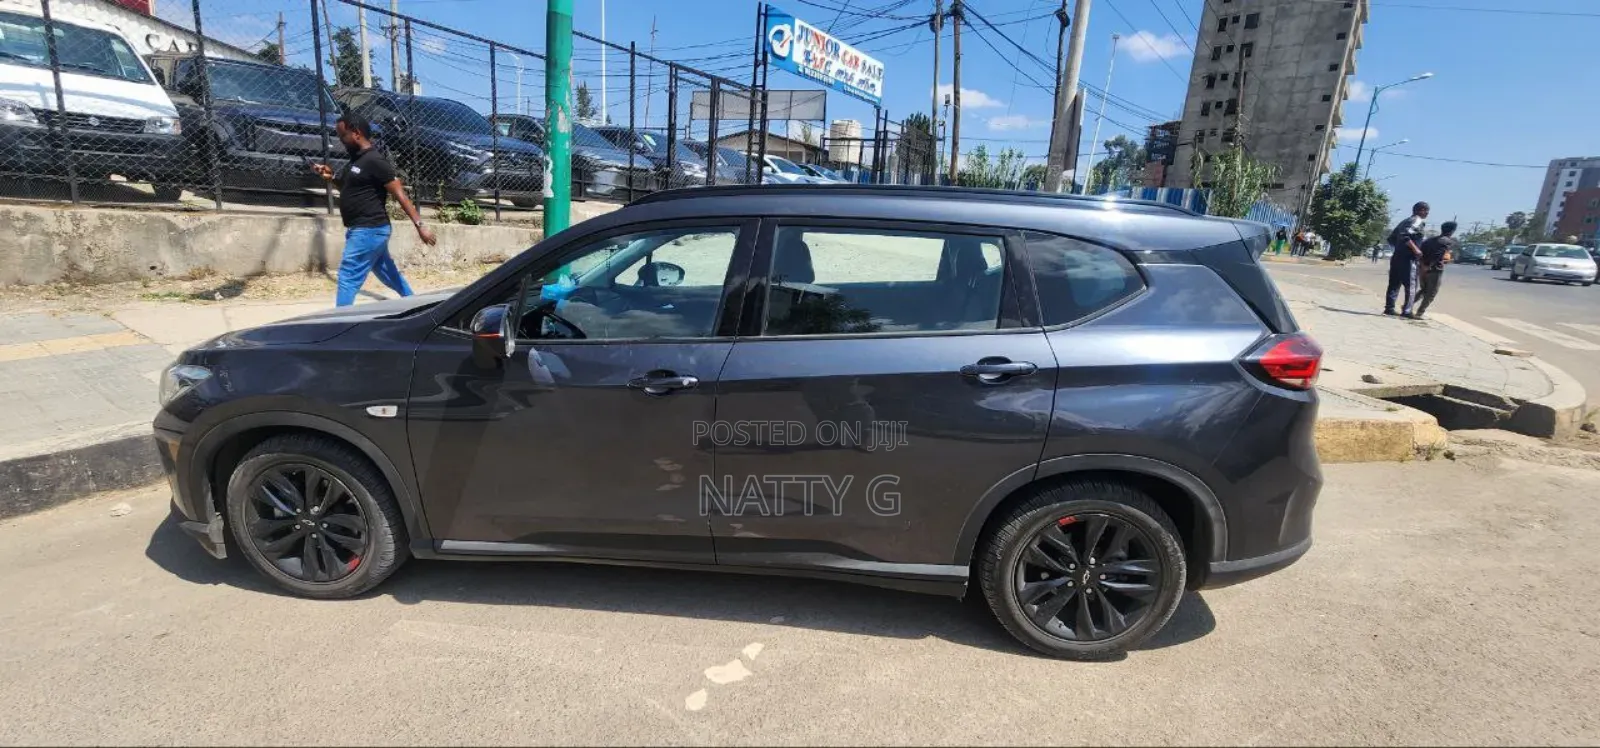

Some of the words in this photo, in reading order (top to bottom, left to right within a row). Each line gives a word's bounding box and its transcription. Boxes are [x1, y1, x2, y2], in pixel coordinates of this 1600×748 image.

[796, 24, 841, 61] JUNIOR
[841, 51, 860, 72] CAR
[860, 59, 884, 82] SALE
